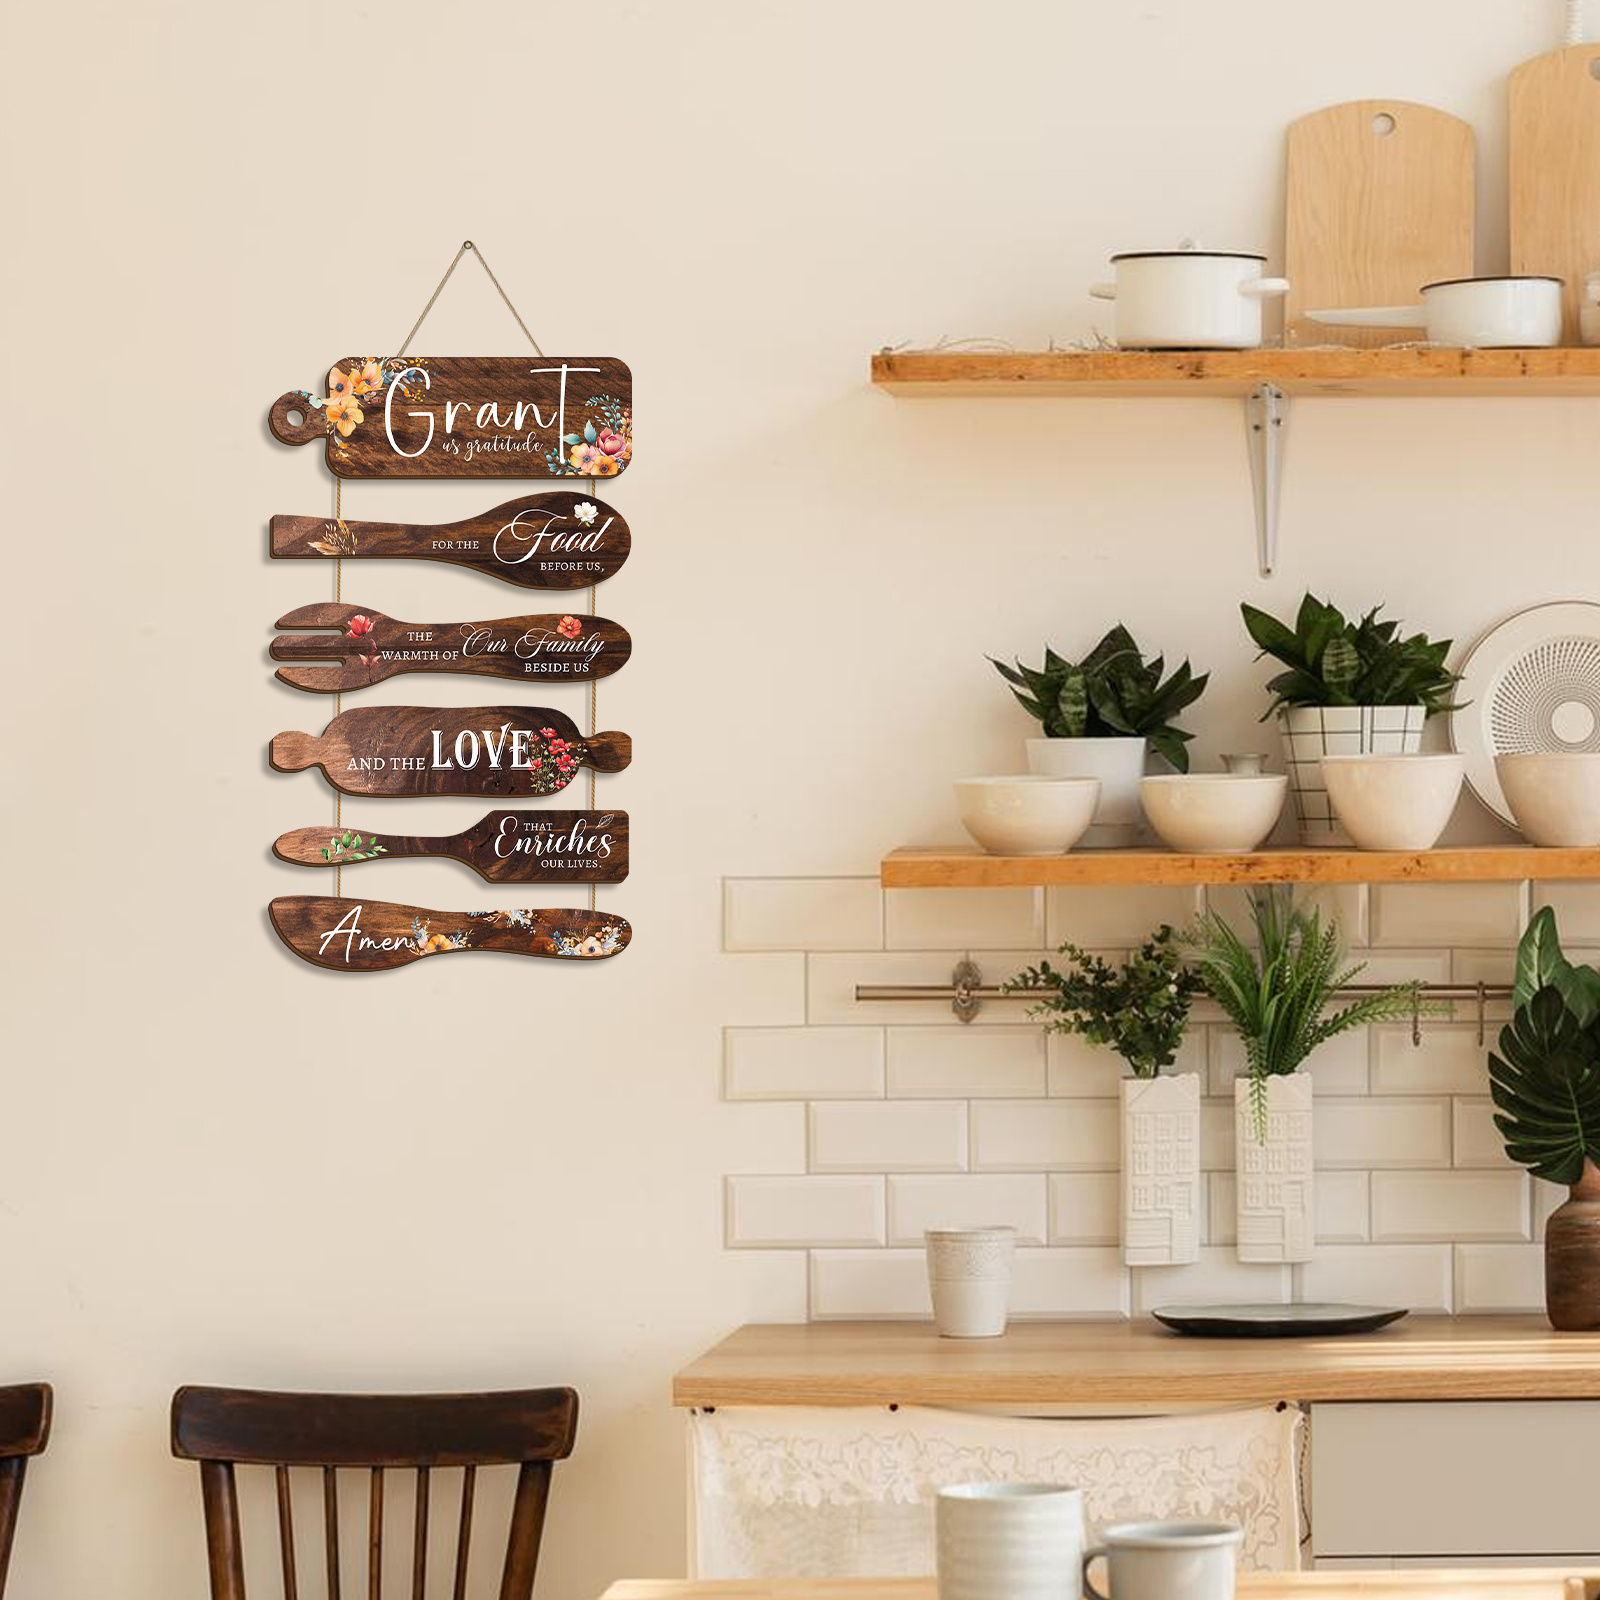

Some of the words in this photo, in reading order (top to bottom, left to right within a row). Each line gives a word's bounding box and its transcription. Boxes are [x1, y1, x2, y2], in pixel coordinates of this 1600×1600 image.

[442, 441, 463, 455] us
[465, 431, 544, 462] gratitude
[432, 540, 454, 550] FOR
[456, 540, 479, 550] THE
[493, 508, 615, 565] Food
[540, 562, 583, 571] BEFORE
[586, 562, 605, 573] US,
[381, 650, 439, 661] WARMTH
[442, 650, 459, 661] OF
[459, 623, 509, 658] Our
[514, 627, 605, 662] Family
[407, 631, 433, 642] THE
[524, 662, 570, 673] BESIDE
[574, 662, 590, 673] US
[347, 757, 386, 771] AND
[389, 757, 426, 771] THE
[430, 721, 536, 772] LOVE
[494, 815, 617, 859] Enriches
[523, 822, 553, 832] THAT
[540, 859, 565, 869] OUR
[567, 859, 602, 869] LIVES.
[318, 905, 414, 964] Amen
